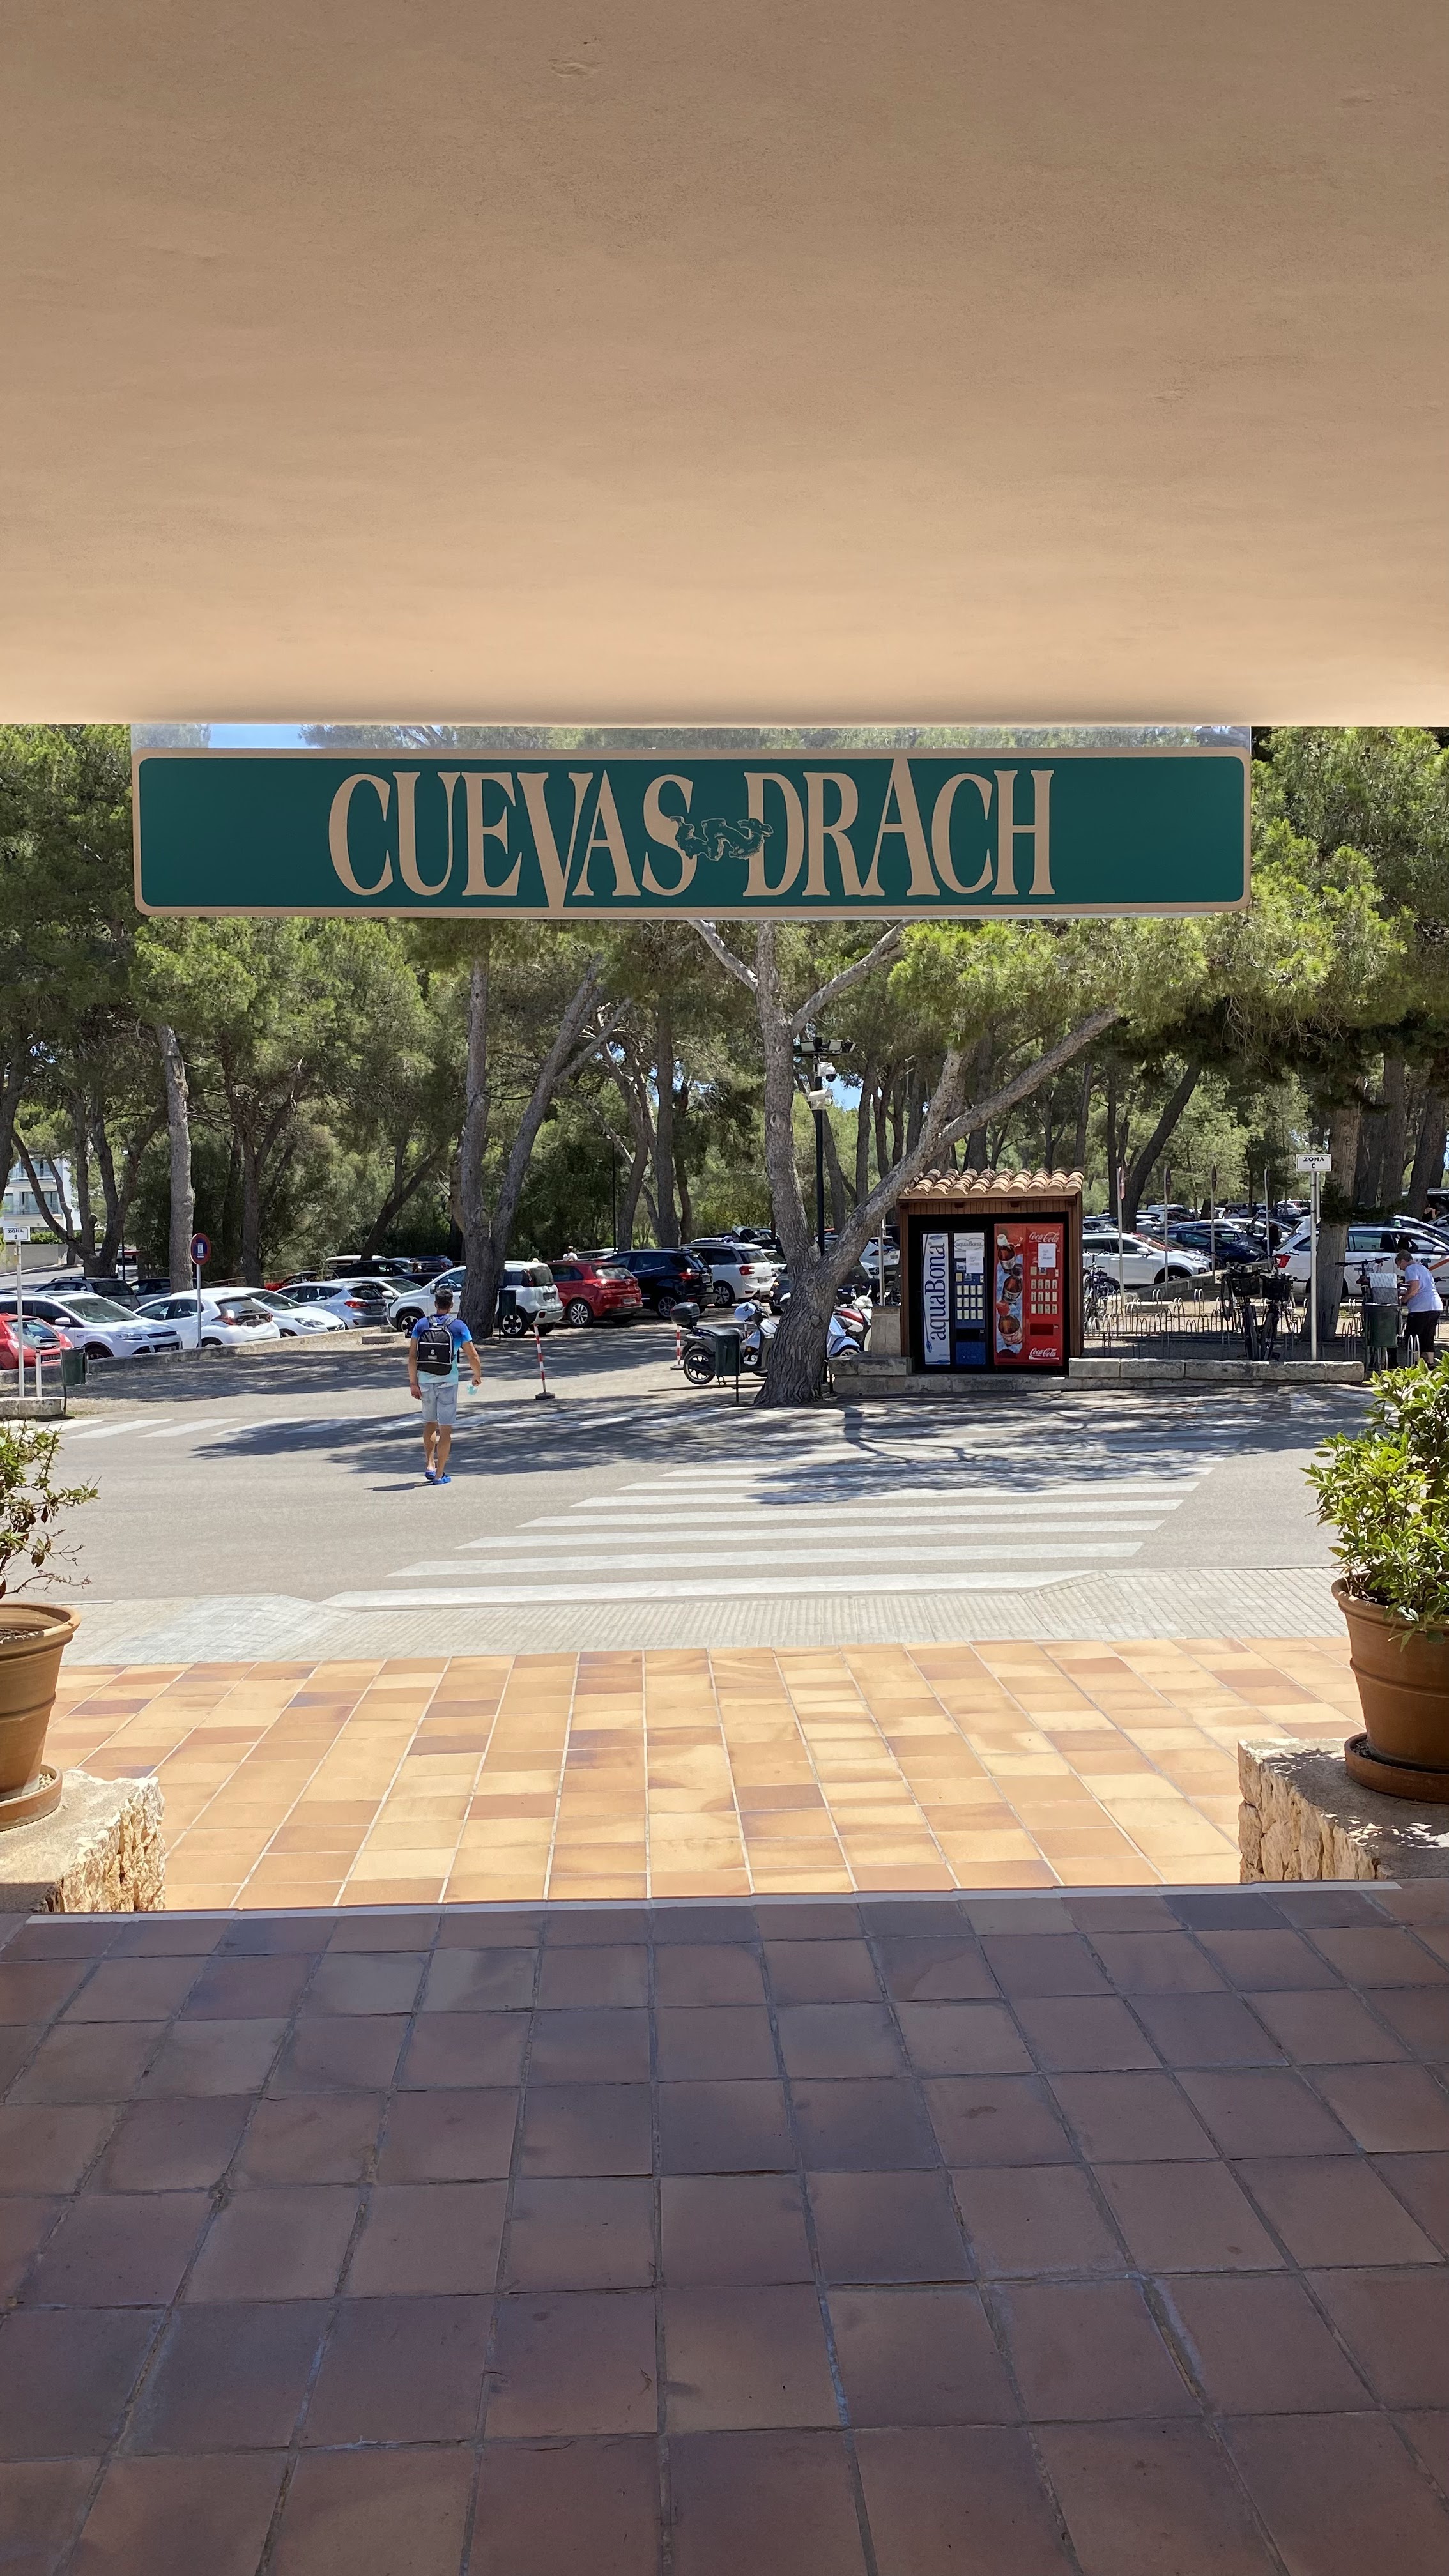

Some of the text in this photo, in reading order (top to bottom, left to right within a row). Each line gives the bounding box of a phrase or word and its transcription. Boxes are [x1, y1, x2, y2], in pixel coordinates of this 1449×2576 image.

[328, 758, 1055, 907] CUEVAS DRACH
[925, 1243, 949, 1340] aquaBona
